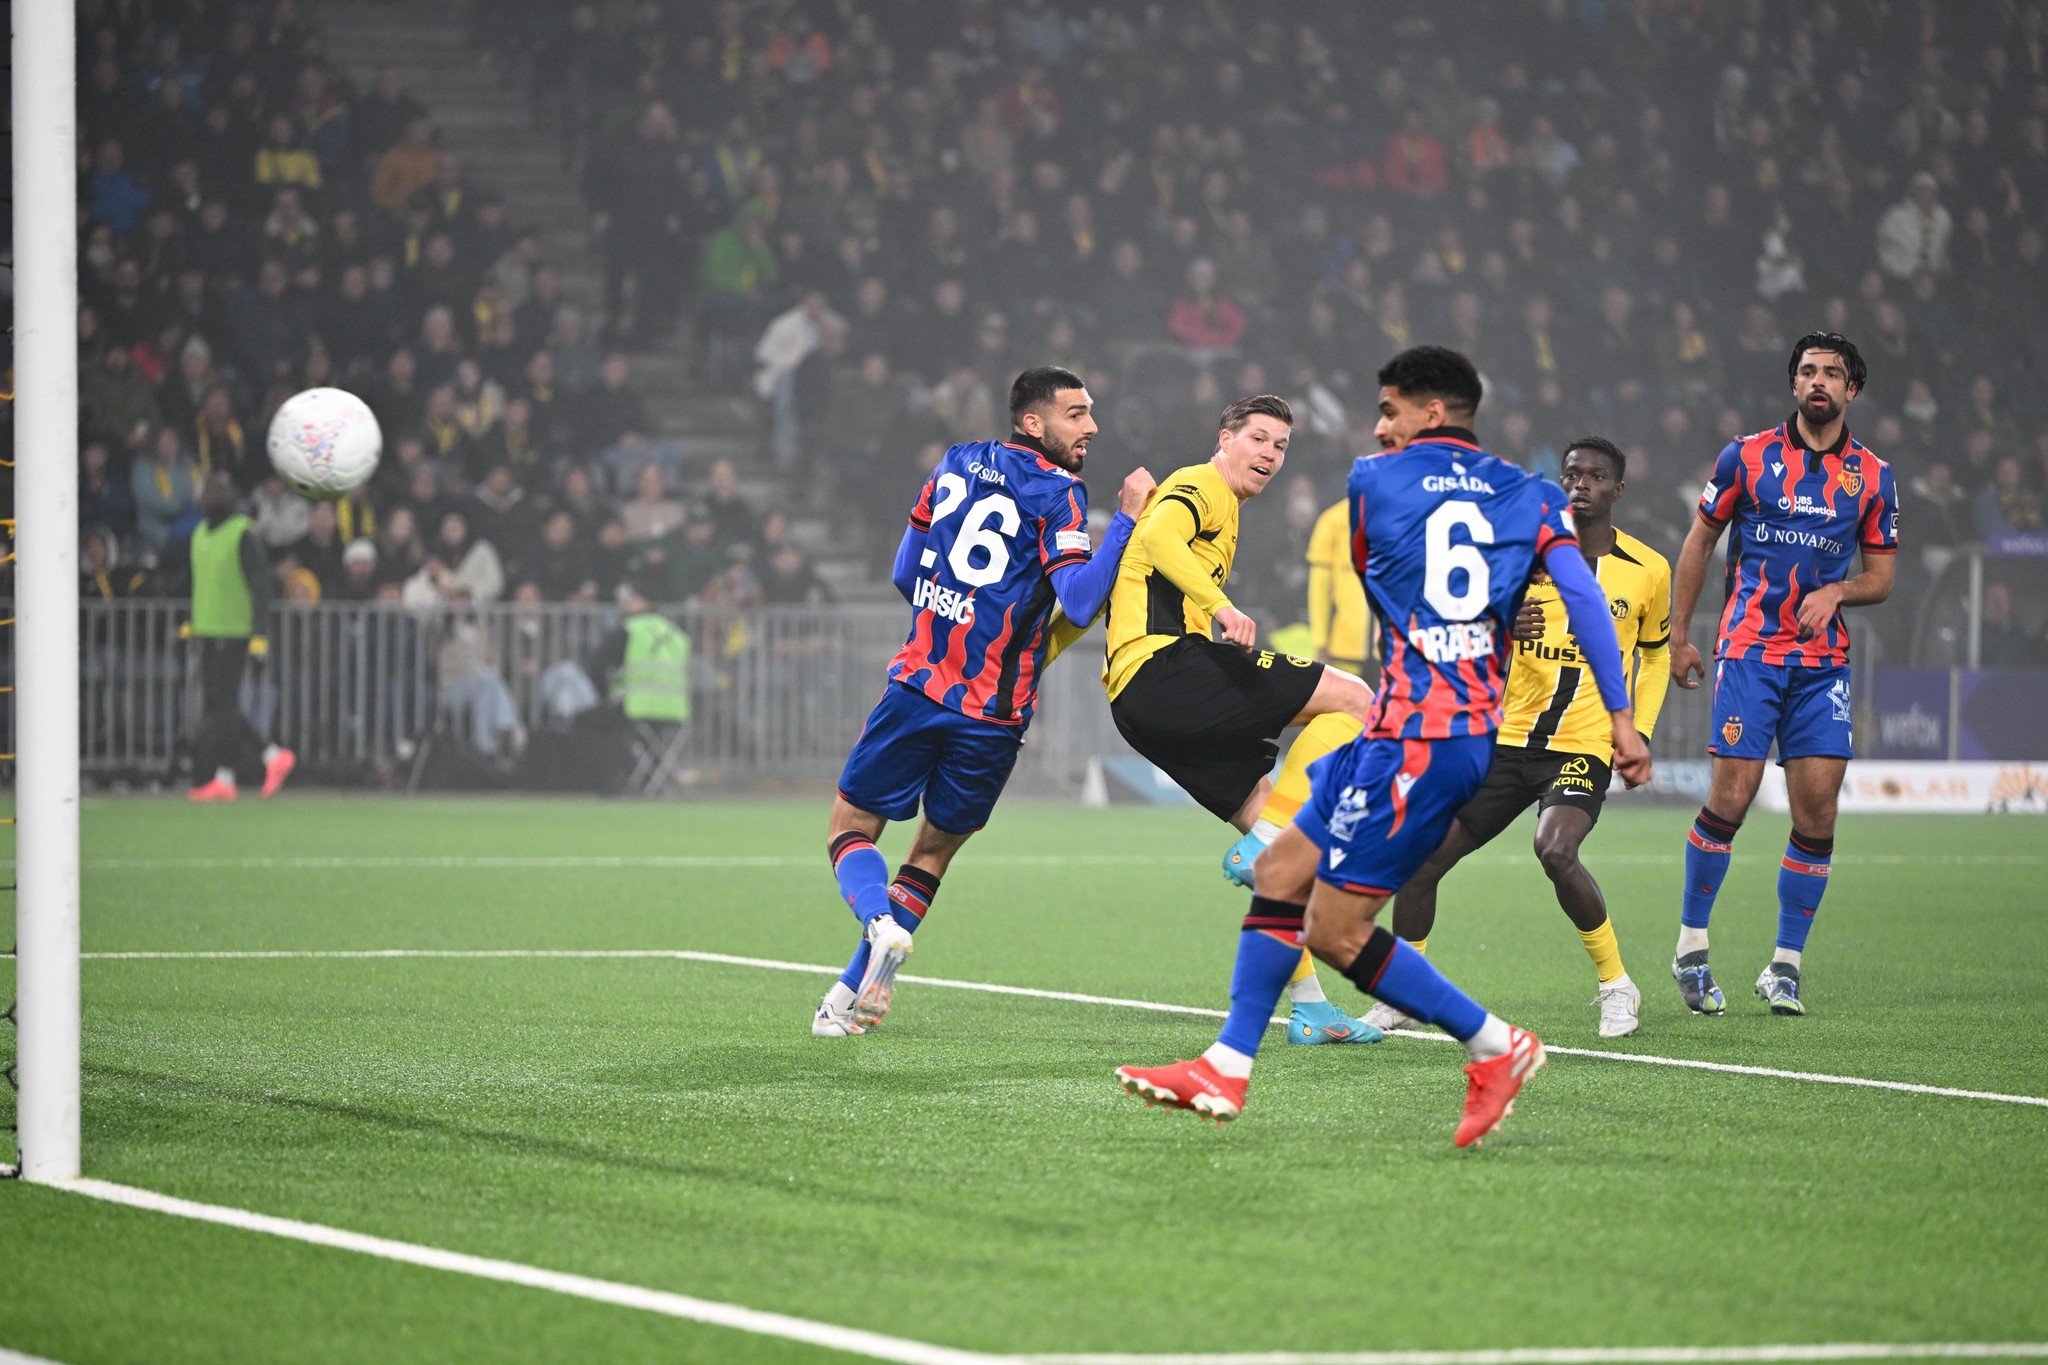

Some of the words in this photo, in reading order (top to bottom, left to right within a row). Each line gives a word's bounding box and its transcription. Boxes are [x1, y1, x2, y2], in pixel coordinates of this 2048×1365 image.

[1422, 474, 1496, 495] GISADA
[1793, 503, 1837, 518] Helpetica
[1794, 495, 1813, 506] UBS
[920, 472, 1021, 588] 26
[1773, 529, 1843, 556] NOVARTIS
[1422, 500, 1495, 621] 6
[1519, 638, 1588, 664] Plus
